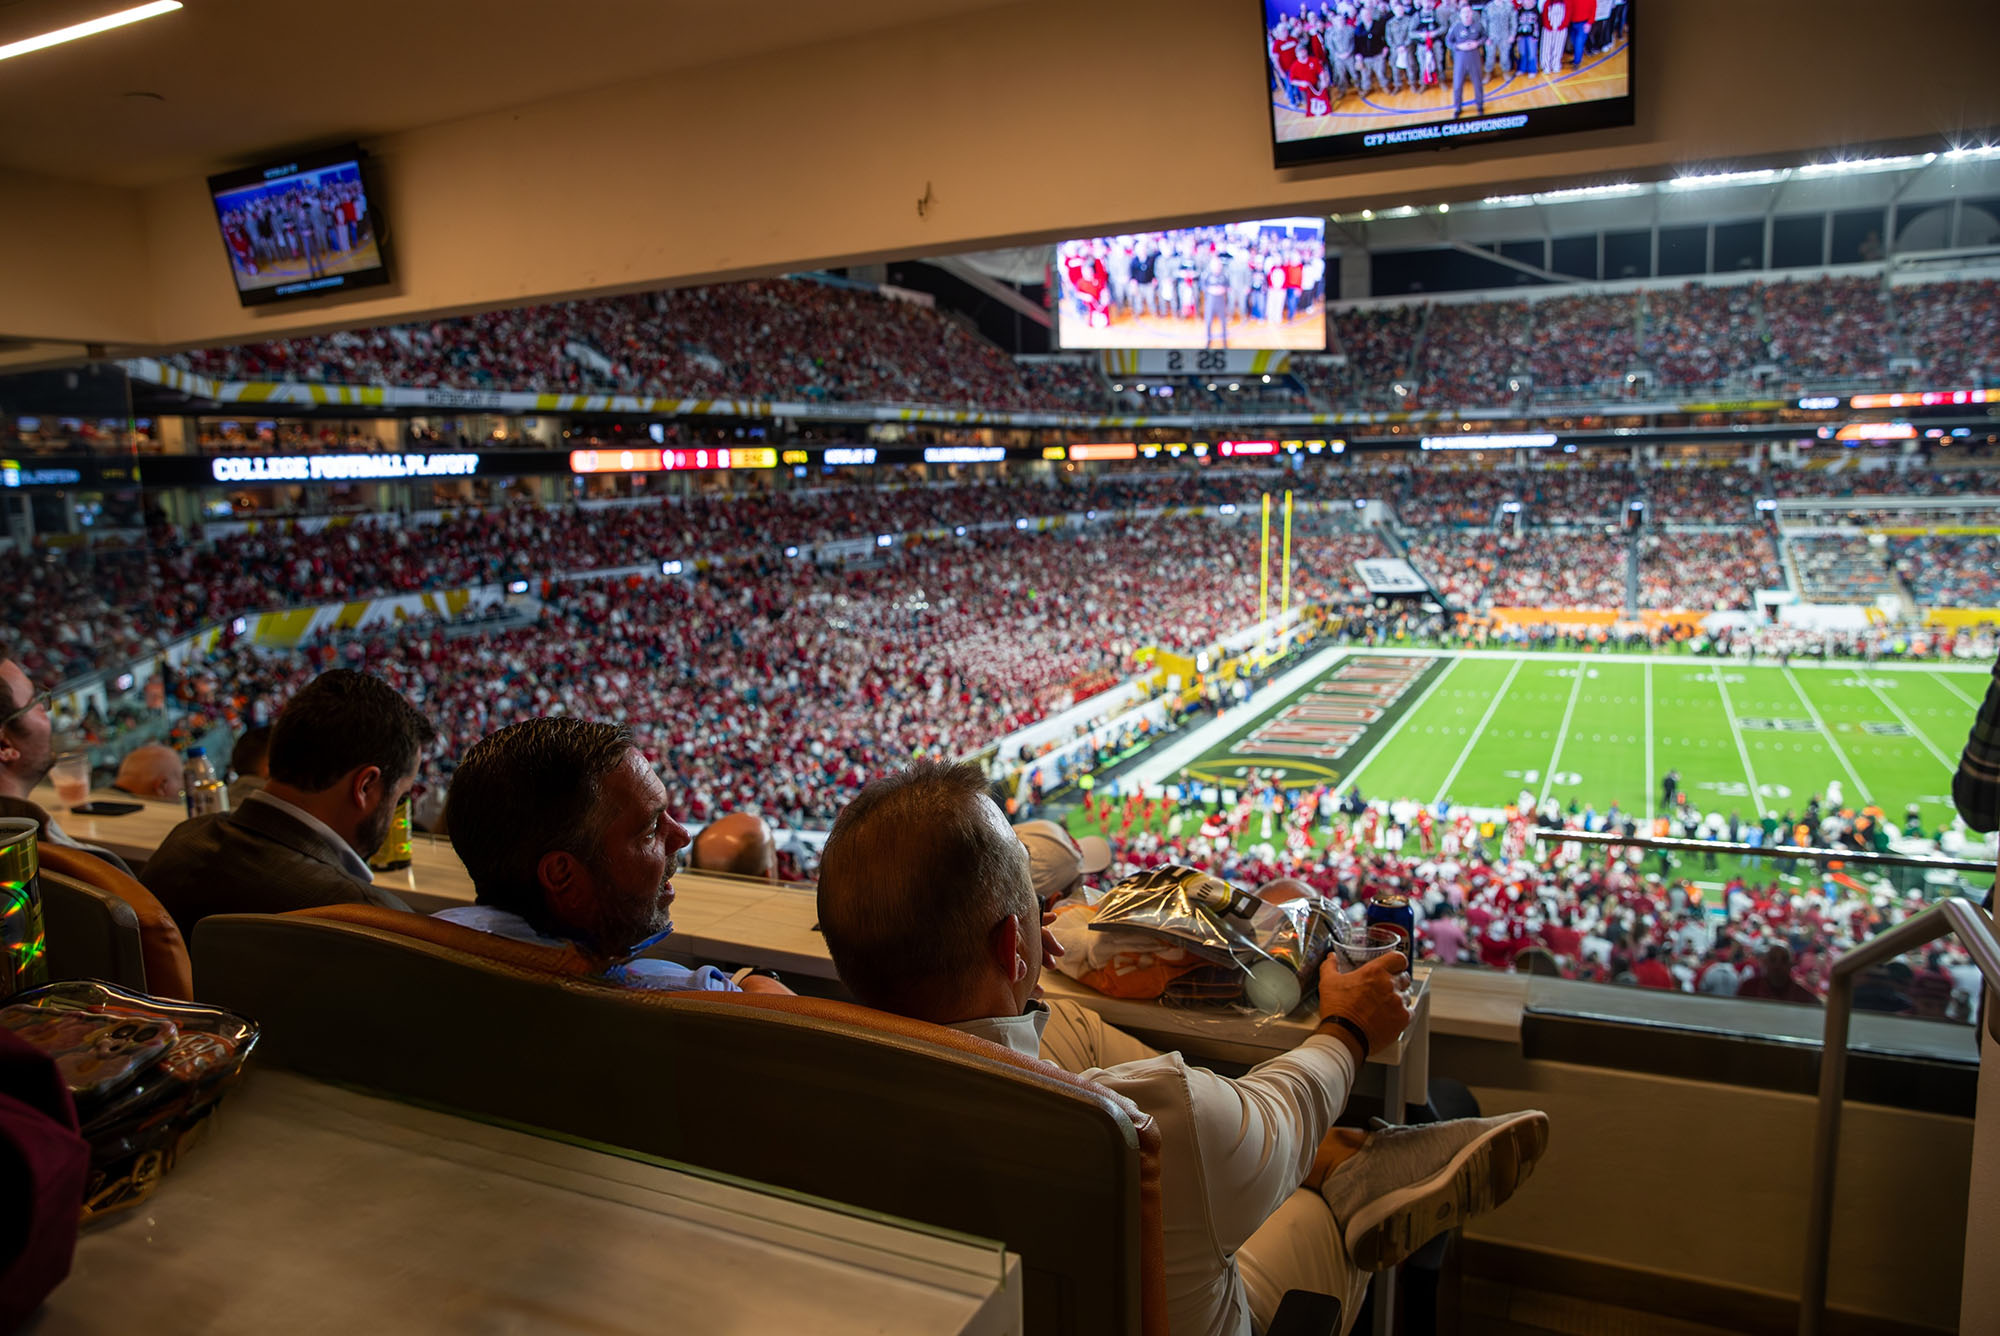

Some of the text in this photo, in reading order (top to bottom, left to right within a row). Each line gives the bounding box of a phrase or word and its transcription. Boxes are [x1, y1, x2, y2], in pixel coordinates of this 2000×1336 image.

[1363, 115, 1529, 147] CFP NATIONAL CHAMPIONSHIP
[212, 453, 480, 481] COLLEGE FOOTBALL PLAYOFF
[1229, 656, 1439, 759] INDIANA
